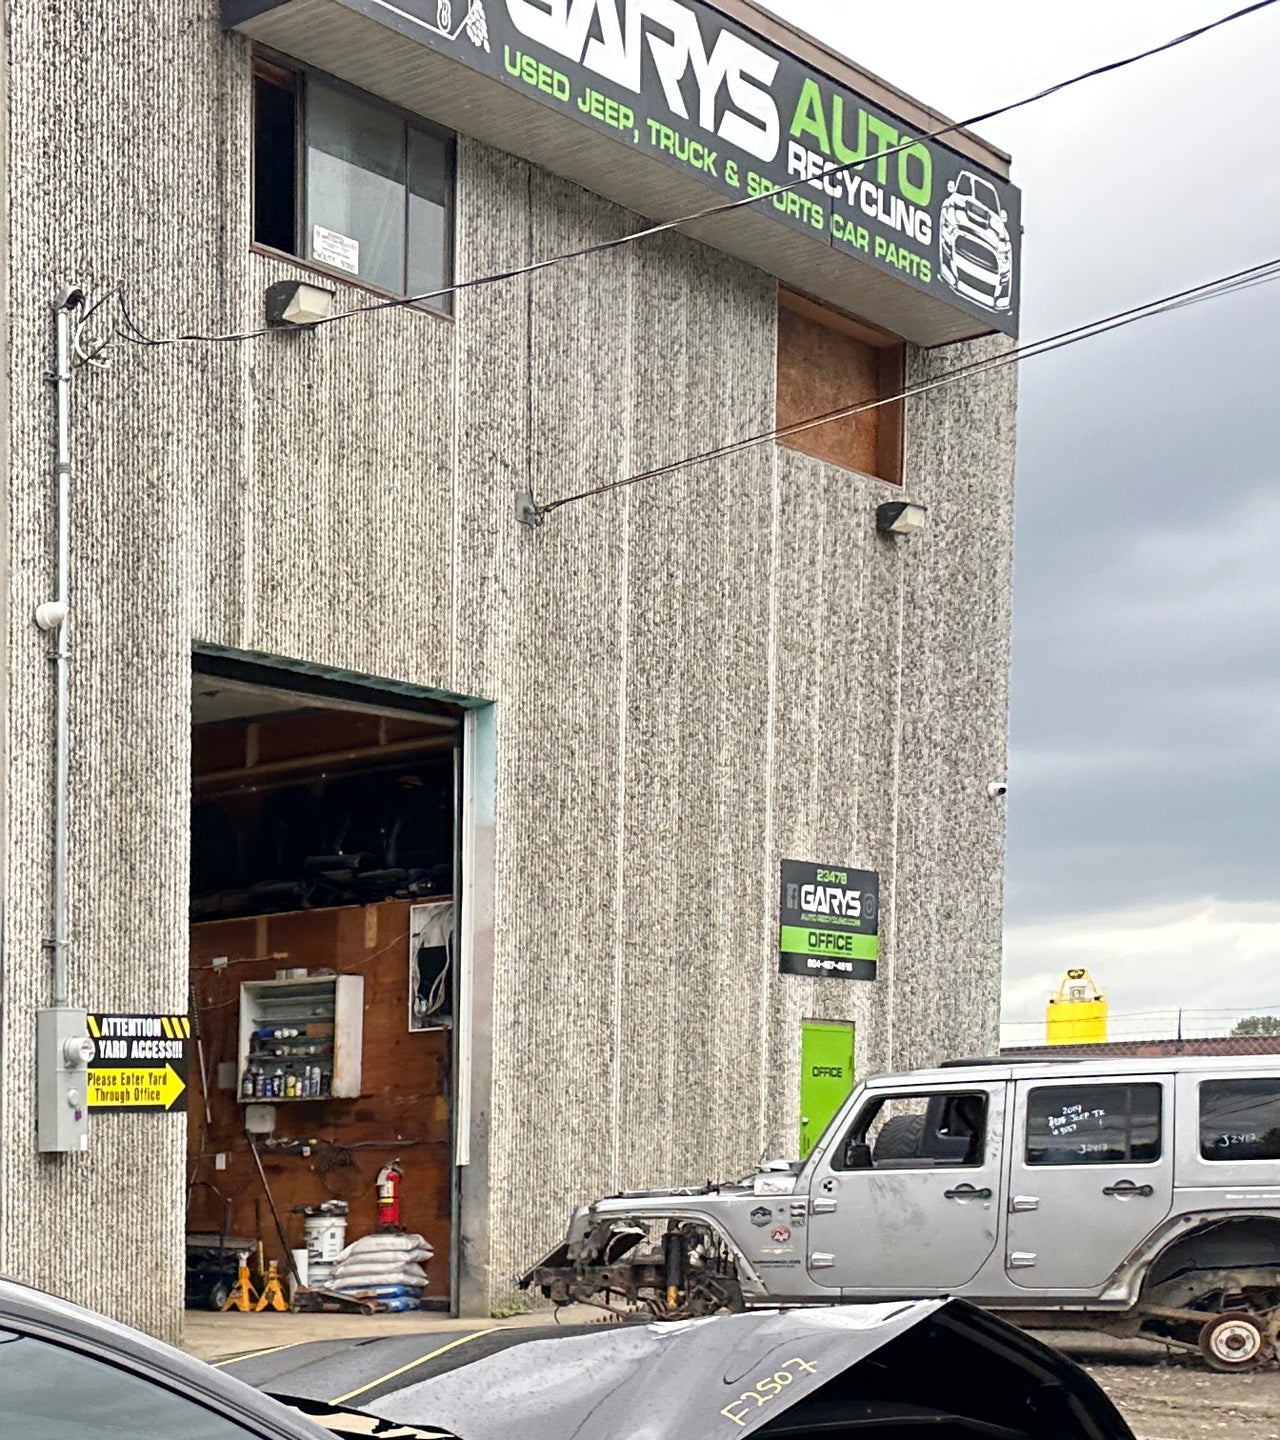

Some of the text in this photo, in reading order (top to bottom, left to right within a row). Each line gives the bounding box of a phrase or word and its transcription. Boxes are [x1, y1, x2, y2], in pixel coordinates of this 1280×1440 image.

[789, 77, 932, 207] AUTO
[504, 44, 932, 284] USED JEEP, TRUCK & SPORTS CAR PARTS
[787, 140, 932, 246] RECYCLING
[800, 884, 862, 917] GARYS
[808, 931, 853, 951] OFFICE
[101, 1017, 161, 1037] ATTENTION
[98, 1040, 183, 1059] YARD ACCESS!!!
[87, 1072, 168, 1087] Please Enter Yard
[812, 1066, 842, 1078] OFFICE
[95, 1087, 161, 1104] Through Office
[720, 1357, 818, 1427] F2507
